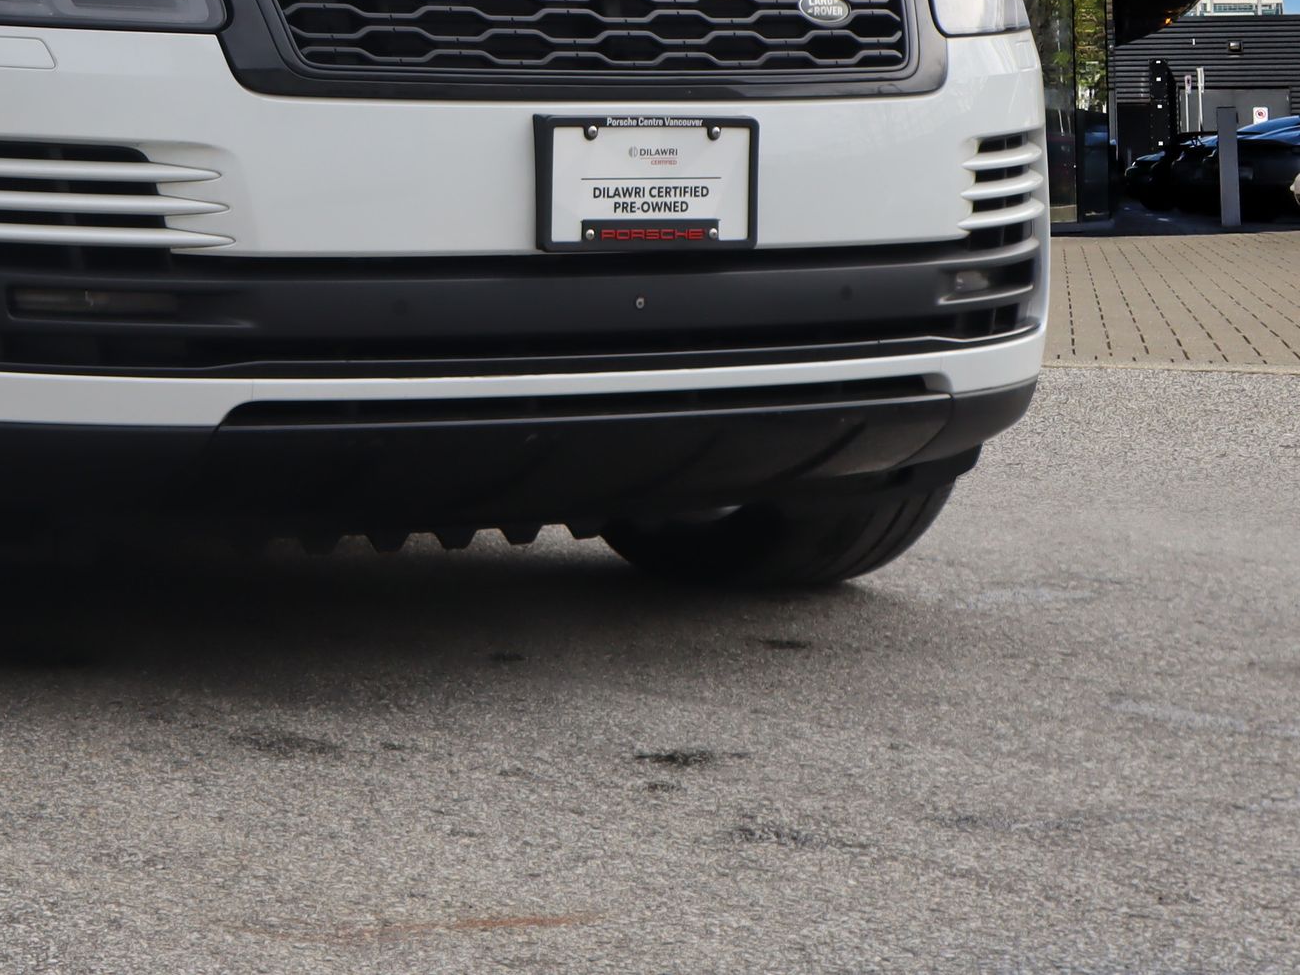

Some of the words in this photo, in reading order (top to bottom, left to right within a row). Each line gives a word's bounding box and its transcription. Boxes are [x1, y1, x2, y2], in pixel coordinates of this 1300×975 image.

[813, 6, 843, 16] ROVER
[606, 117, 638, 127] Porsche
[638, 117, 664, 127] Centre
[664, 117, 704, 127] Vancouver
[639, 148, 678, 156] DILAWRI
[593, 187, 646, 198] DILAWRI
[648, 186, 709, 198] CERTIFIED
[613, 201, 689, 213] PRE-OWNED
[602, 229, 705, 240] PORSCHE
